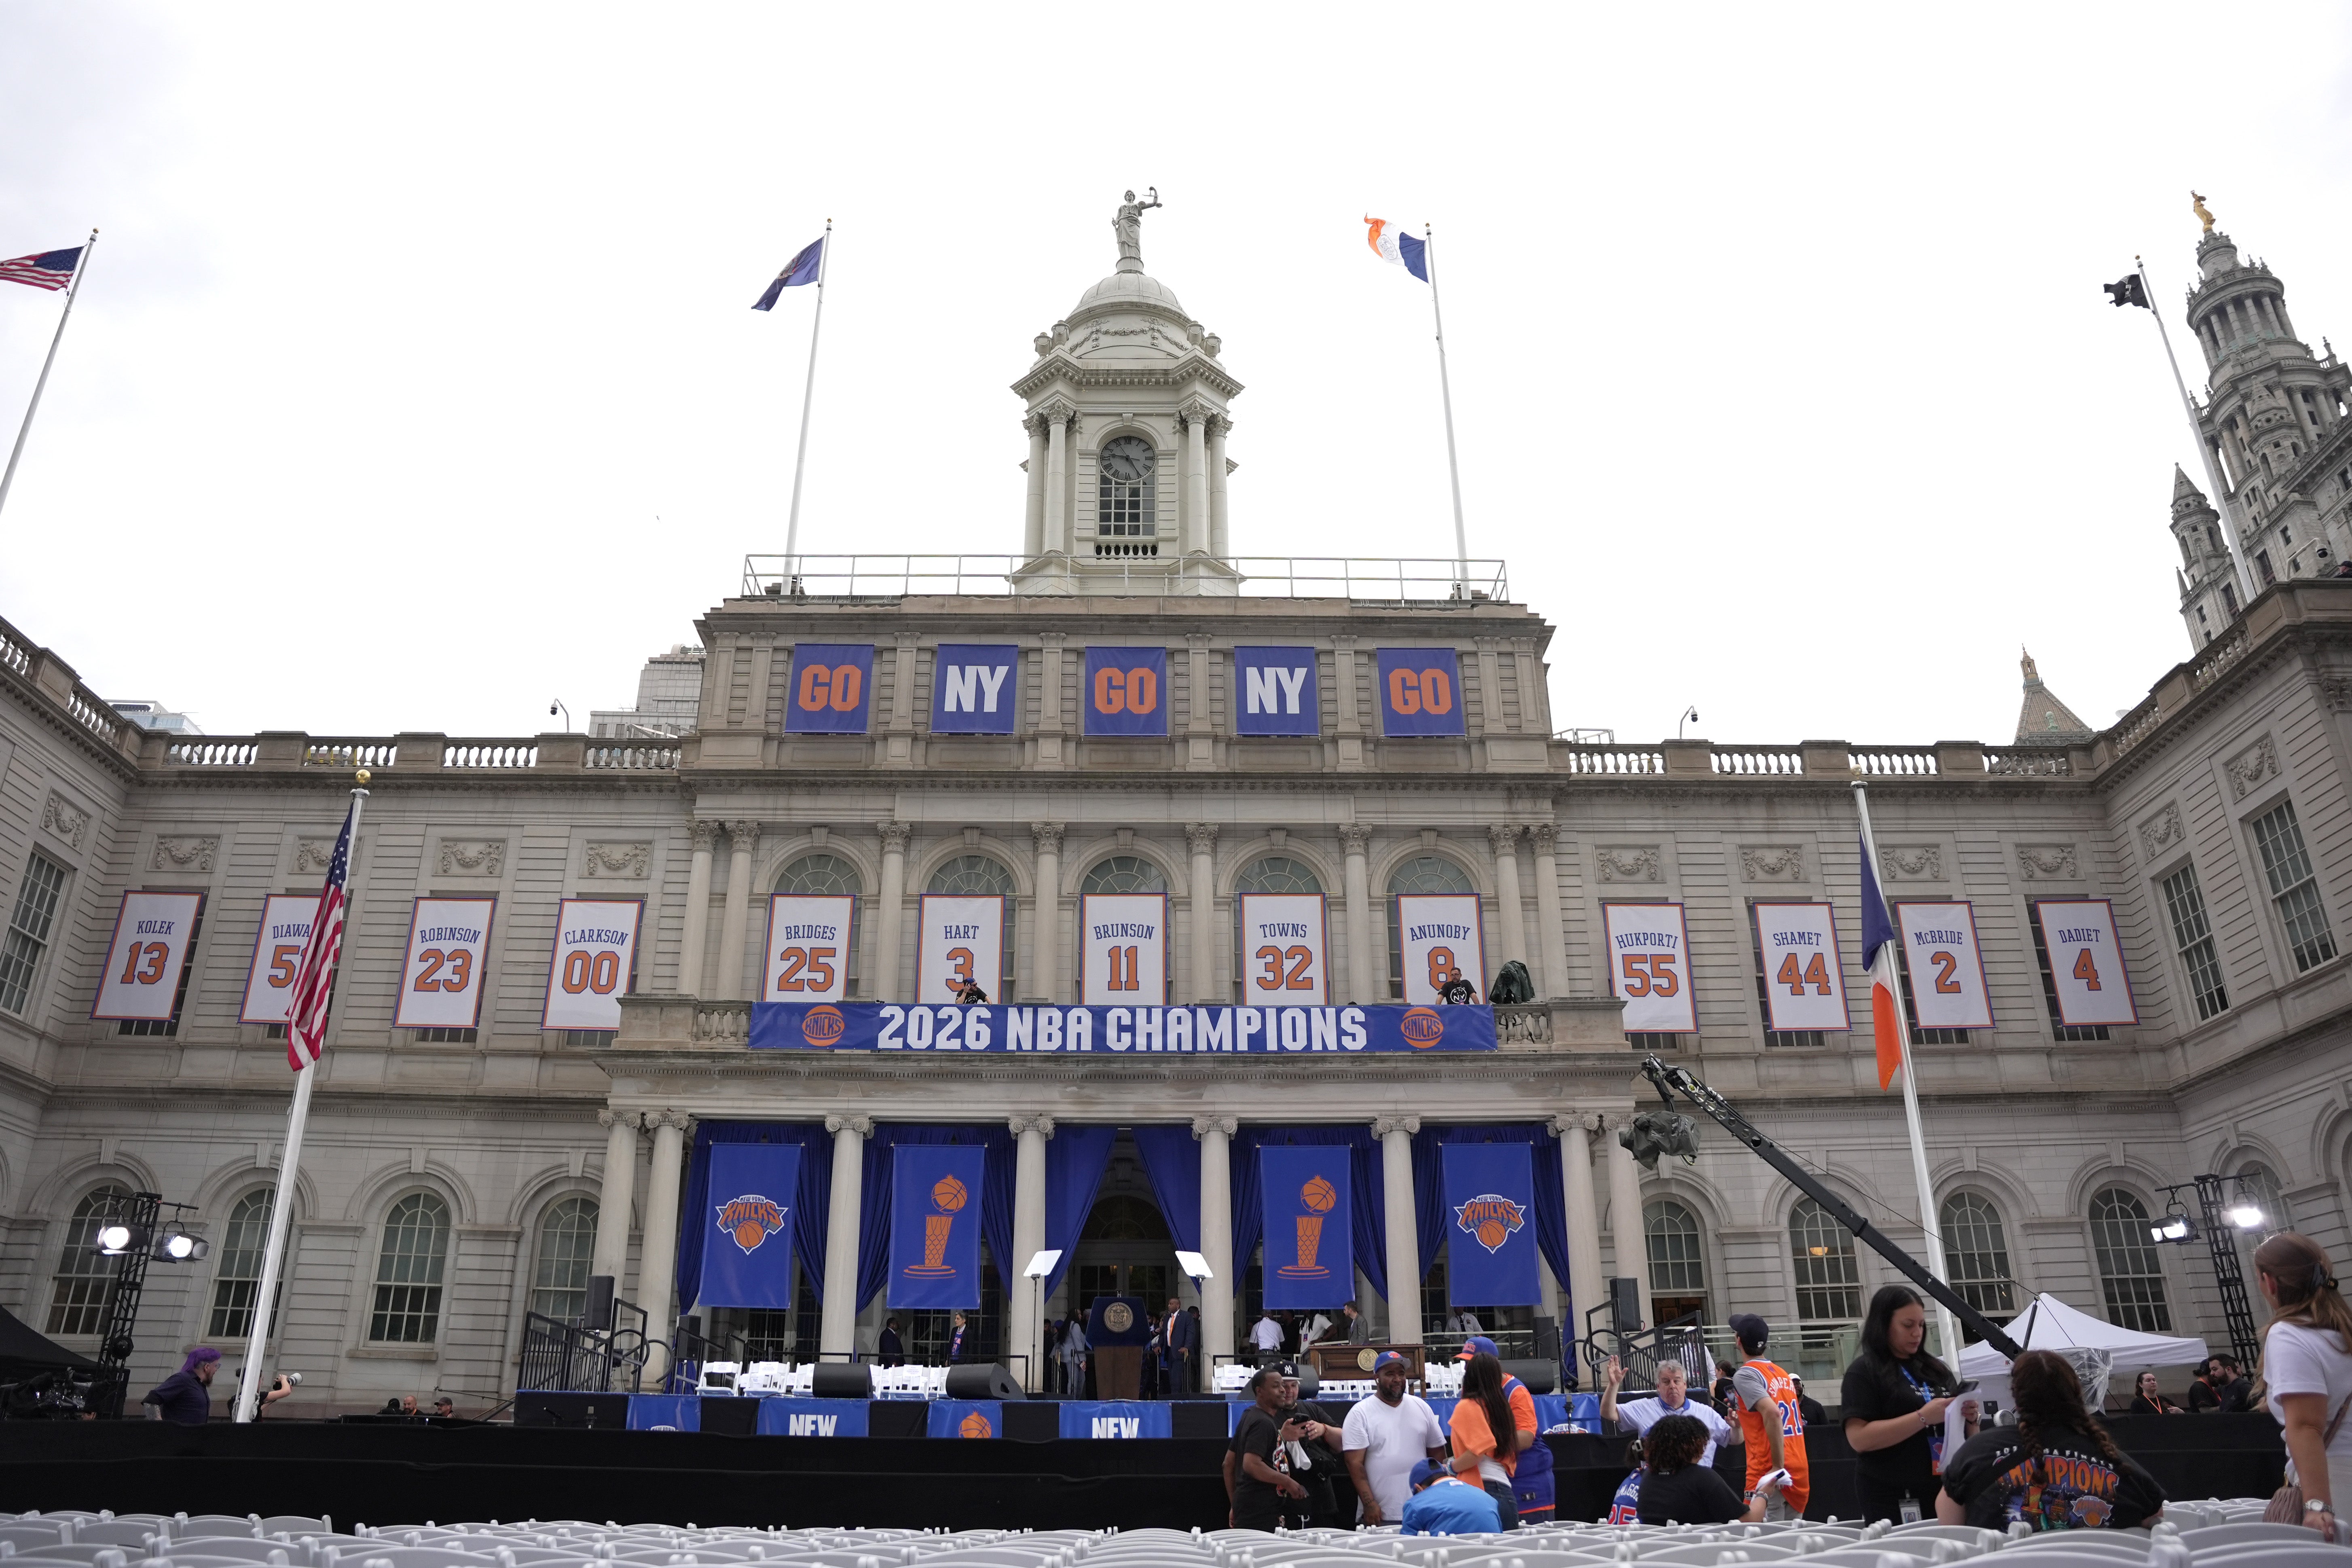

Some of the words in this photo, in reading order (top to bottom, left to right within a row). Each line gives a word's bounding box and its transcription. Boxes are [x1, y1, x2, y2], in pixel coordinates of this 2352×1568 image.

[799, 665, 861, 711] GO
[945, 666, 1009, 712] NY
[1095, 668, 1156, 713] GO
[1246, 667, 1307, 713] NY
[1390, 669, 1451, 714] GO
[137, 920, 175, 935] KOLEK
[419, 927, 482, 944] ROBINSON
[565, 929, 629, 946] CLARKSON
[785, 925, 836, 941] BRIDGES
[944, 925, 979, 940] HART
[1094, 923, 1155, 940] BRUNSON
[1259, 923, 1307, 938] TOWNS
[1410, 924, 1470, 942] ANUNOBY
[1615, 932, 1678, 949] HUKPORTI
[1772, 931, 1821, 946] SHAMET
[2058, 927, 2100, 944] DADIET
[121, 942, 169, 984] 13
[268, 945, 307, 988] 5
[414, 949, 472, 992] 23
[562, 950, 620, 995] 00
[778, 947, 836, 993] 25
[945, 947, 974, 992] 3
[1108, 946, 1139, 991] 11
[1256, 945, 1313, 990] 32
[1428, 946, 1455, 991] 8
[1622, 952, 1679, 997] 55
[1777, 952, 1832, 996] 44
[1931, 951, 1961, 994] 2
[2073, 948, 2101, 991] 4
[805, 1016, 842, 1036] KNICKS
[878, 1006, 991, 1049] 2026
[1007, 1007, 1091, 1050] NBA
[1107, 1008, 1366, 1051] CHAMPIONS
[1404, 1018, 1440, 1038] KNICKS
[719, 1201, 782, 1226] KNICKS
[1460, 1200, 1522, 1225] KNICKS
[1777, 1399, 1803, 1436] 21
